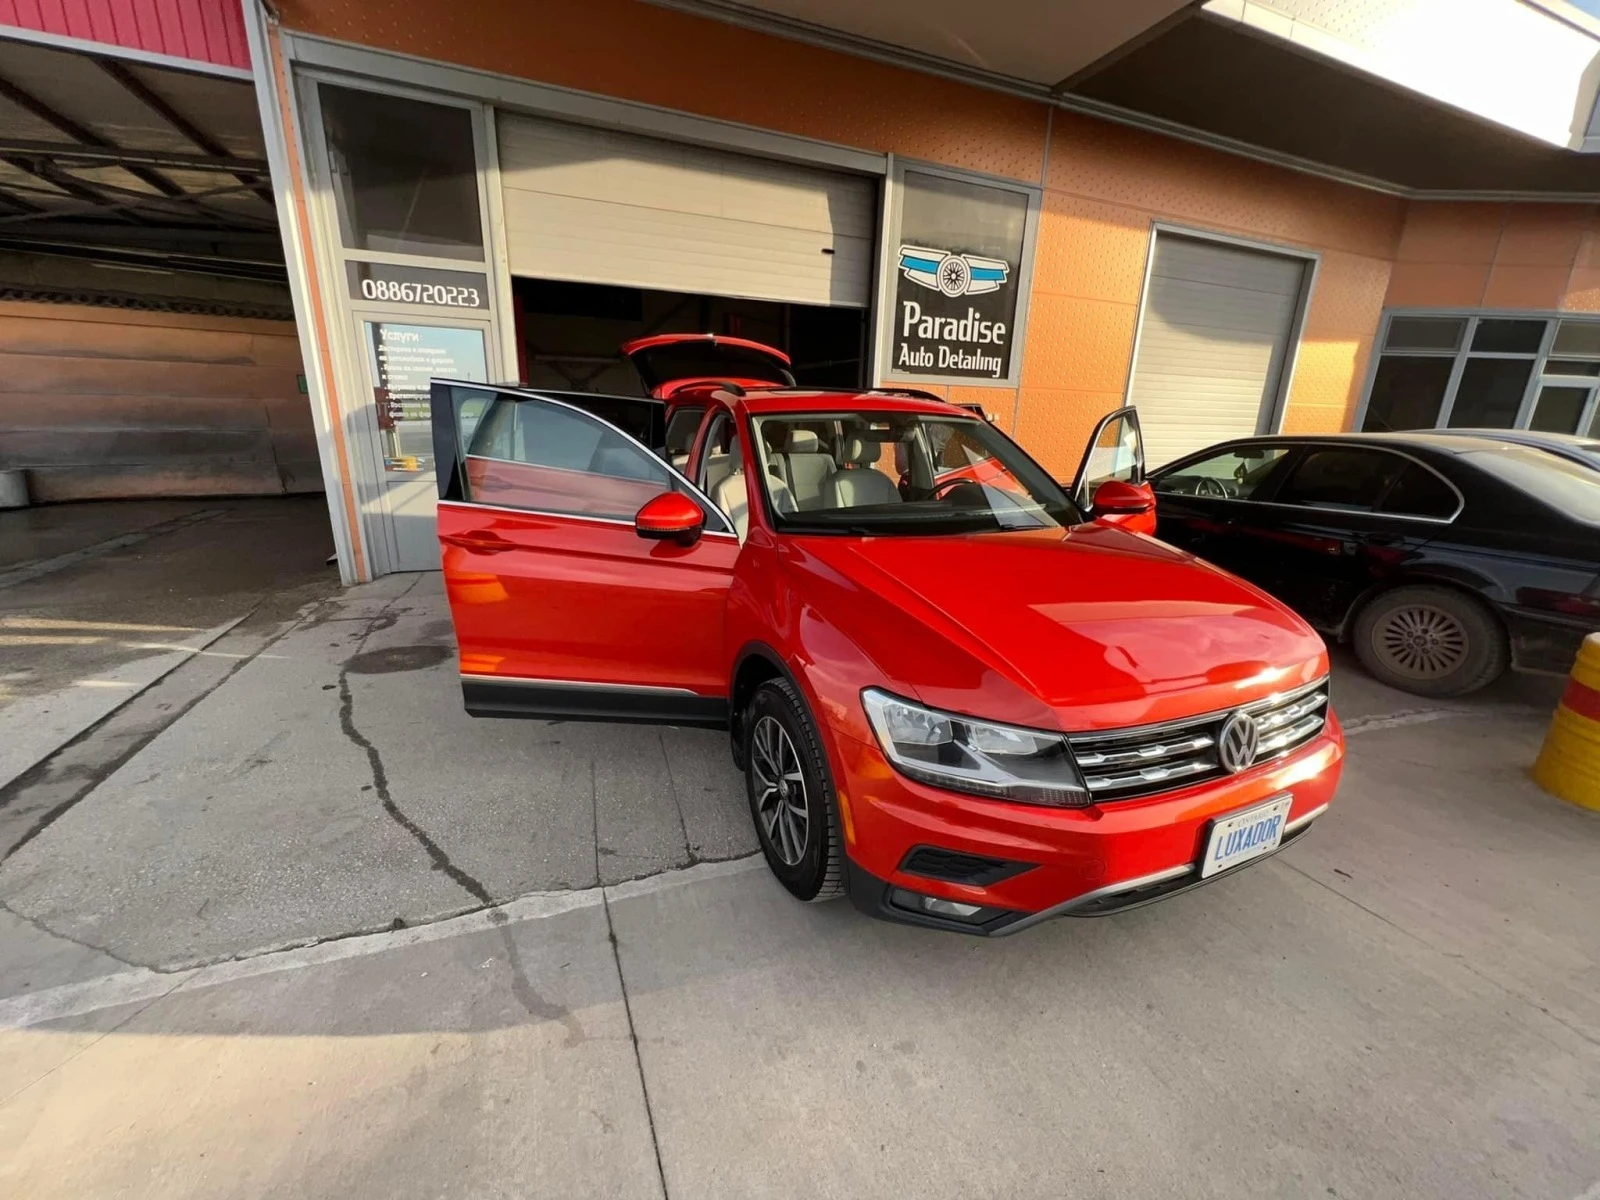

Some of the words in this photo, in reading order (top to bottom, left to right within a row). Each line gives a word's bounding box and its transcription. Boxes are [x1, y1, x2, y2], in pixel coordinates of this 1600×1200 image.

[362, 279, 480, 308] 0886720223
[903, 301, 1006, 345] Paradise
[898, 343, 934, 367] Auto
[938, 346, 1002, 378] Detailing
[1214, 814, 1281, 861] LUXADOR
